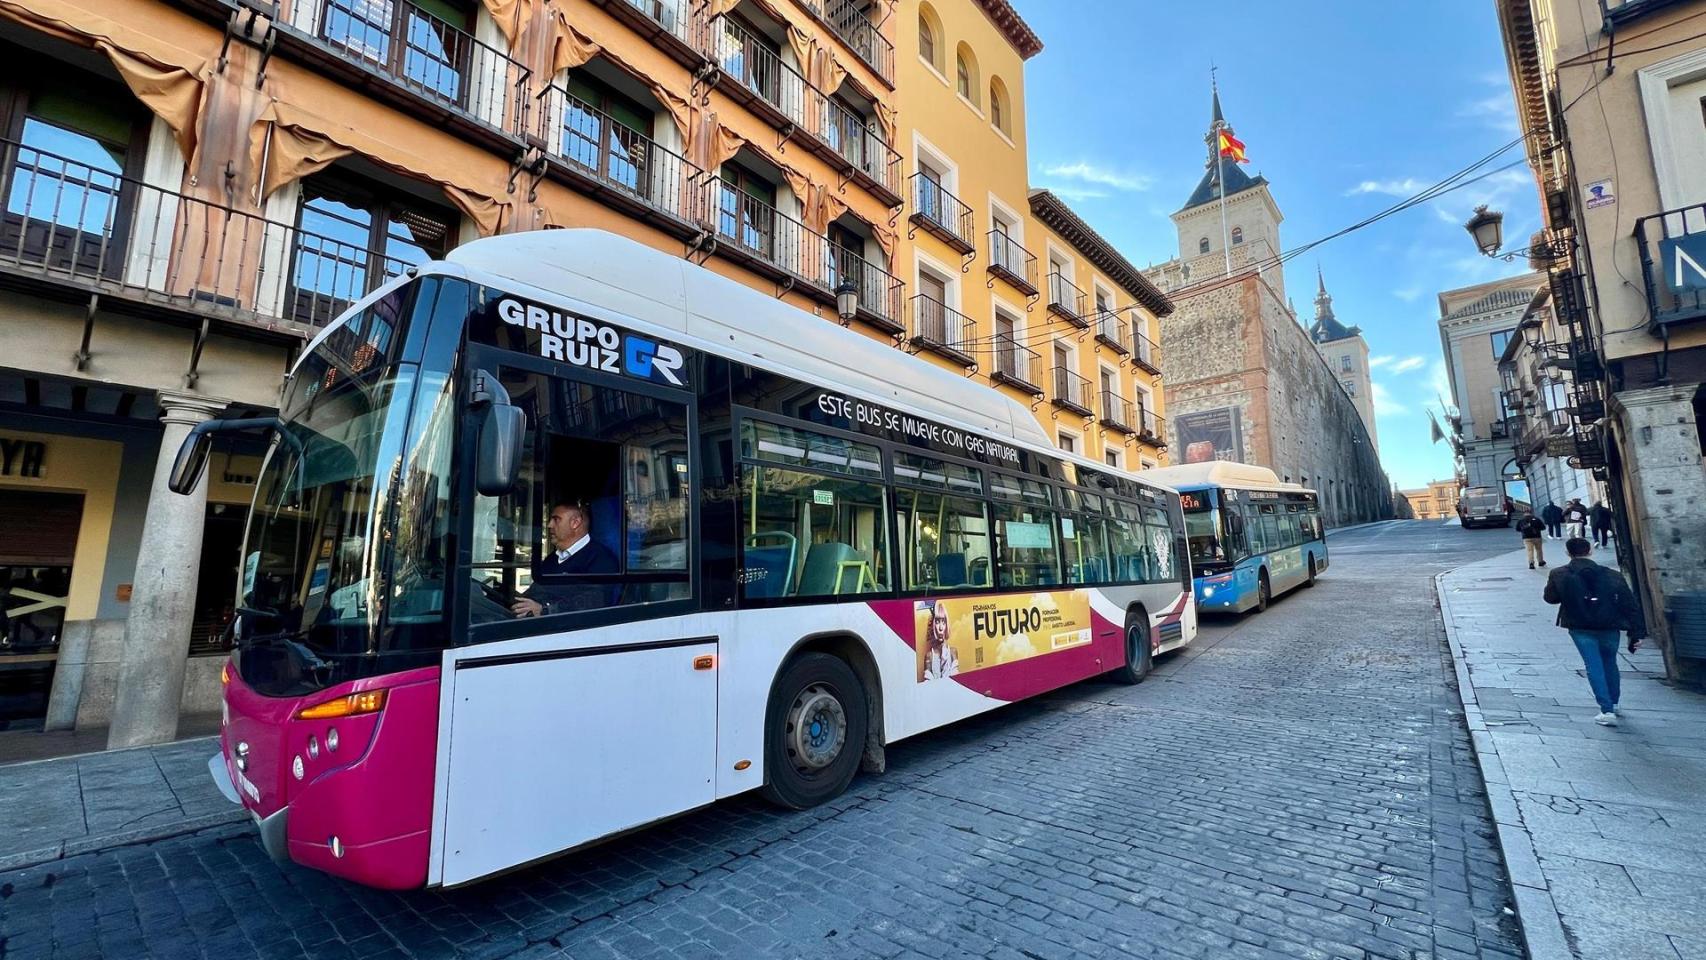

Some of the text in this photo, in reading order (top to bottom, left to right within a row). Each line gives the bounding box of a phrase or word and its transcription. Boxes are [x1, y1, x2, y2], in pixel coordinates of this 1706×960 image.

[498, 298, 620, 350] GRUPO
[541, 332, 620, 374] RUIZ
[624, 335, 684, 386] GR
[818, 394, 1020, 463] ESTE BUS SE MUEVE CON GAS NATURAL
[973, 606, 1041, 640] FUTURO
